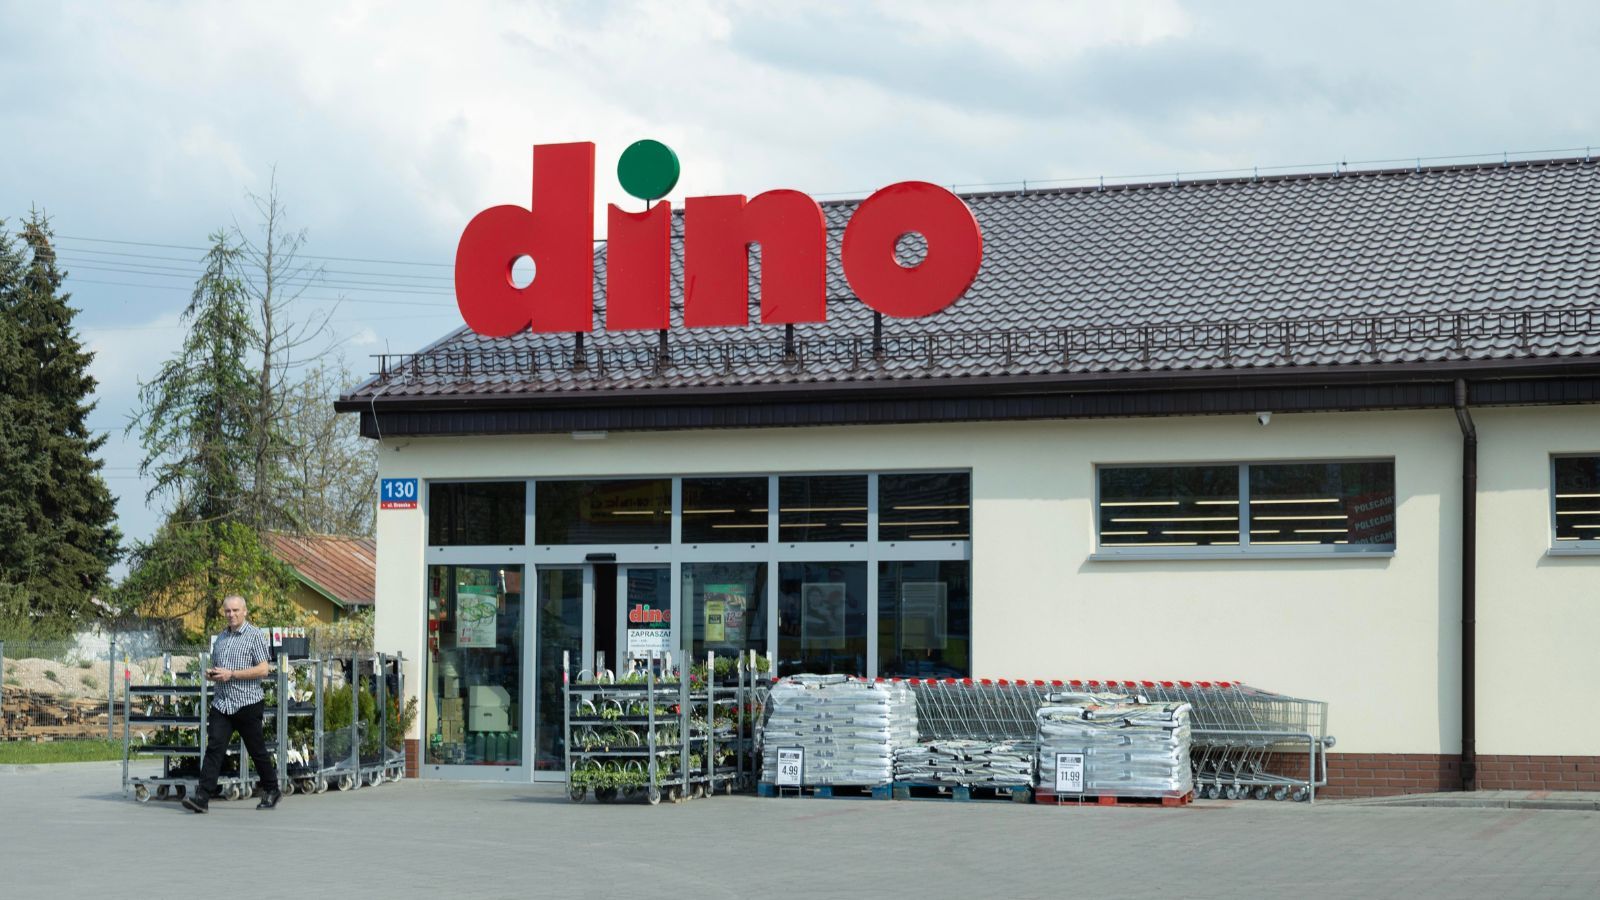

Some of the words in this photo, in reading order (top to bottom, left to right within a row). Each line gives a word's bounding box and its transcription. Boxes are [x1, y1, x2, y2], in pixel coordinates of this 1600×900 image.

[455, 139, 982, 337] dino
[385, 481, 414, 498] 130
[1354, 530, 1394, 545] POLECAM
[629, 604, 671, 622] dino
[782, 766, 798, 775] 4.99
[1061, 771, 1080, 781] 11.99
